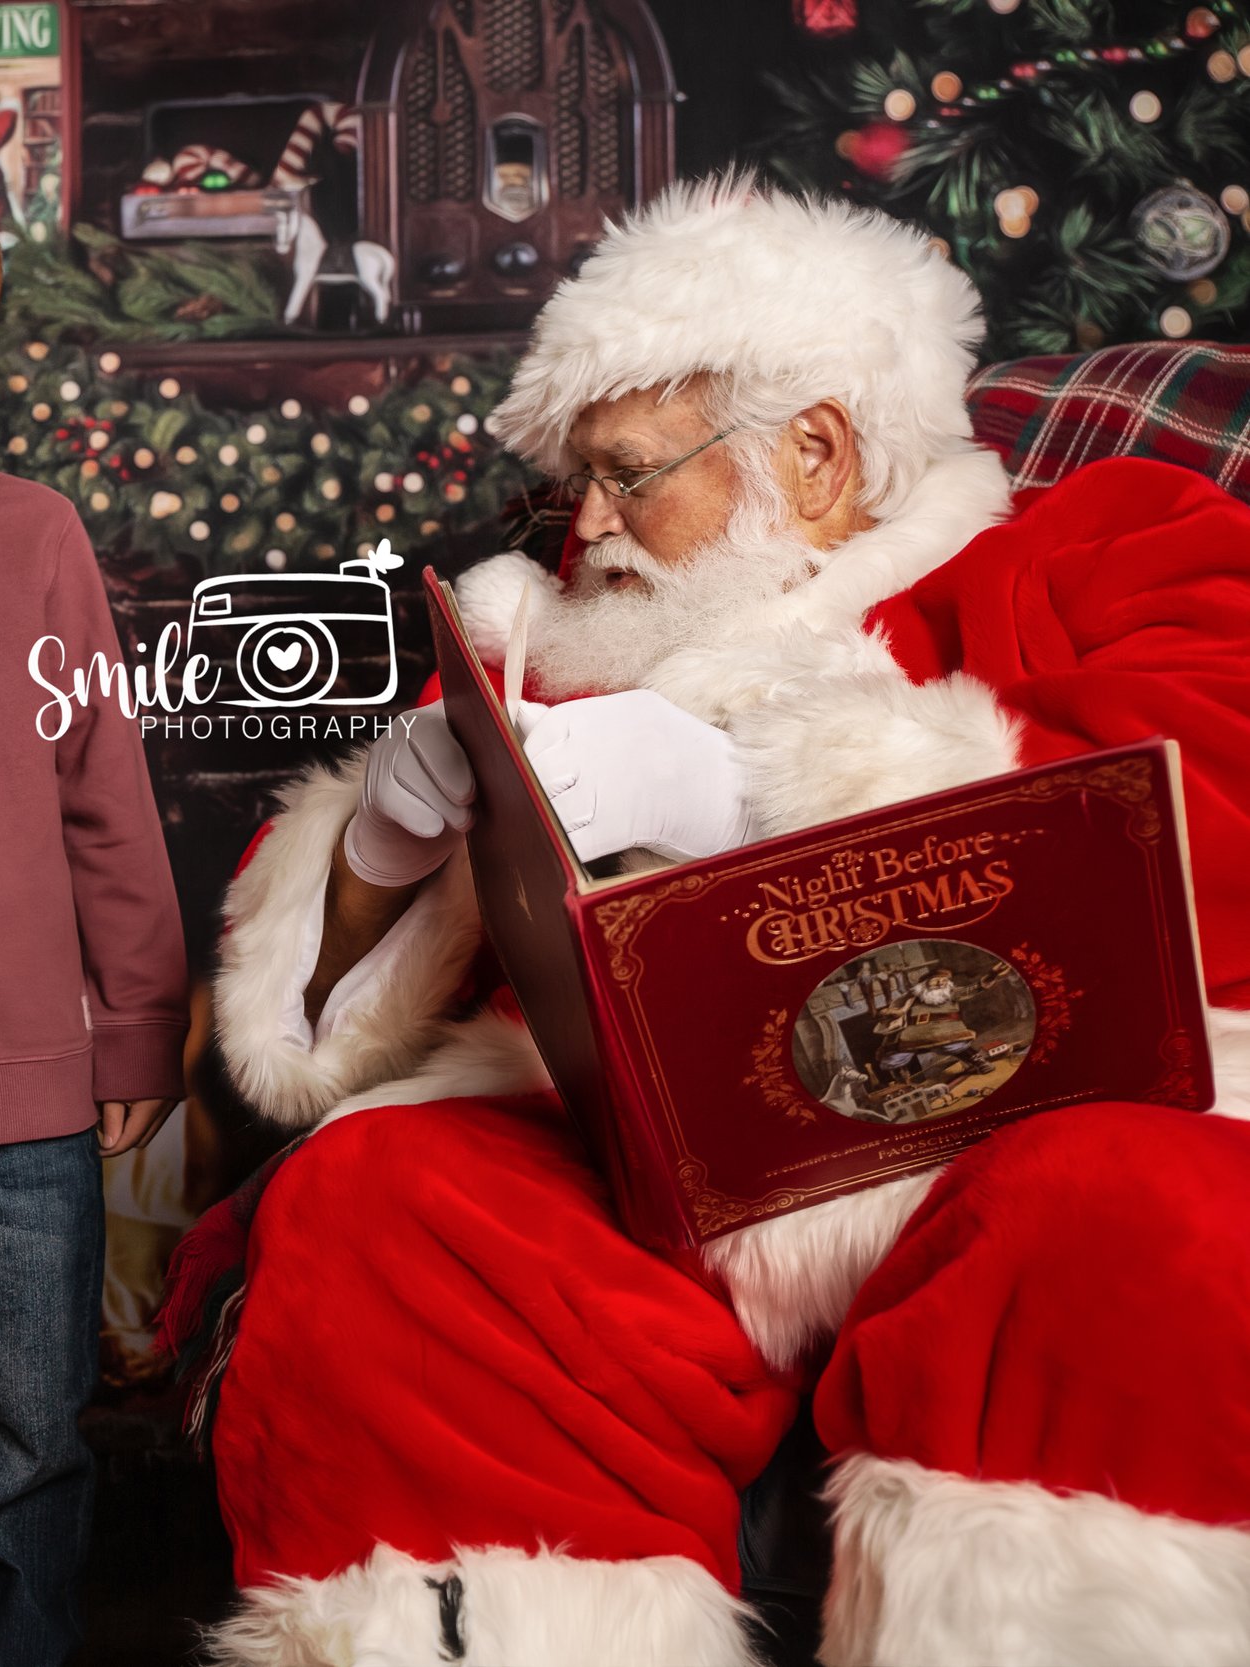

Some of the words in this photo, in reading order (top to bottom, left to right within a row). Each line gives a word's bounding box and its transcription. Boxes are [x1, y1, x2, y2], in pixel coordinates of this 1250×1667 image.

[746, 860, 1015, 964] CHRISTMAS
[758, 864, 864, 911] Night
[869, 832, 994, 883] Before
